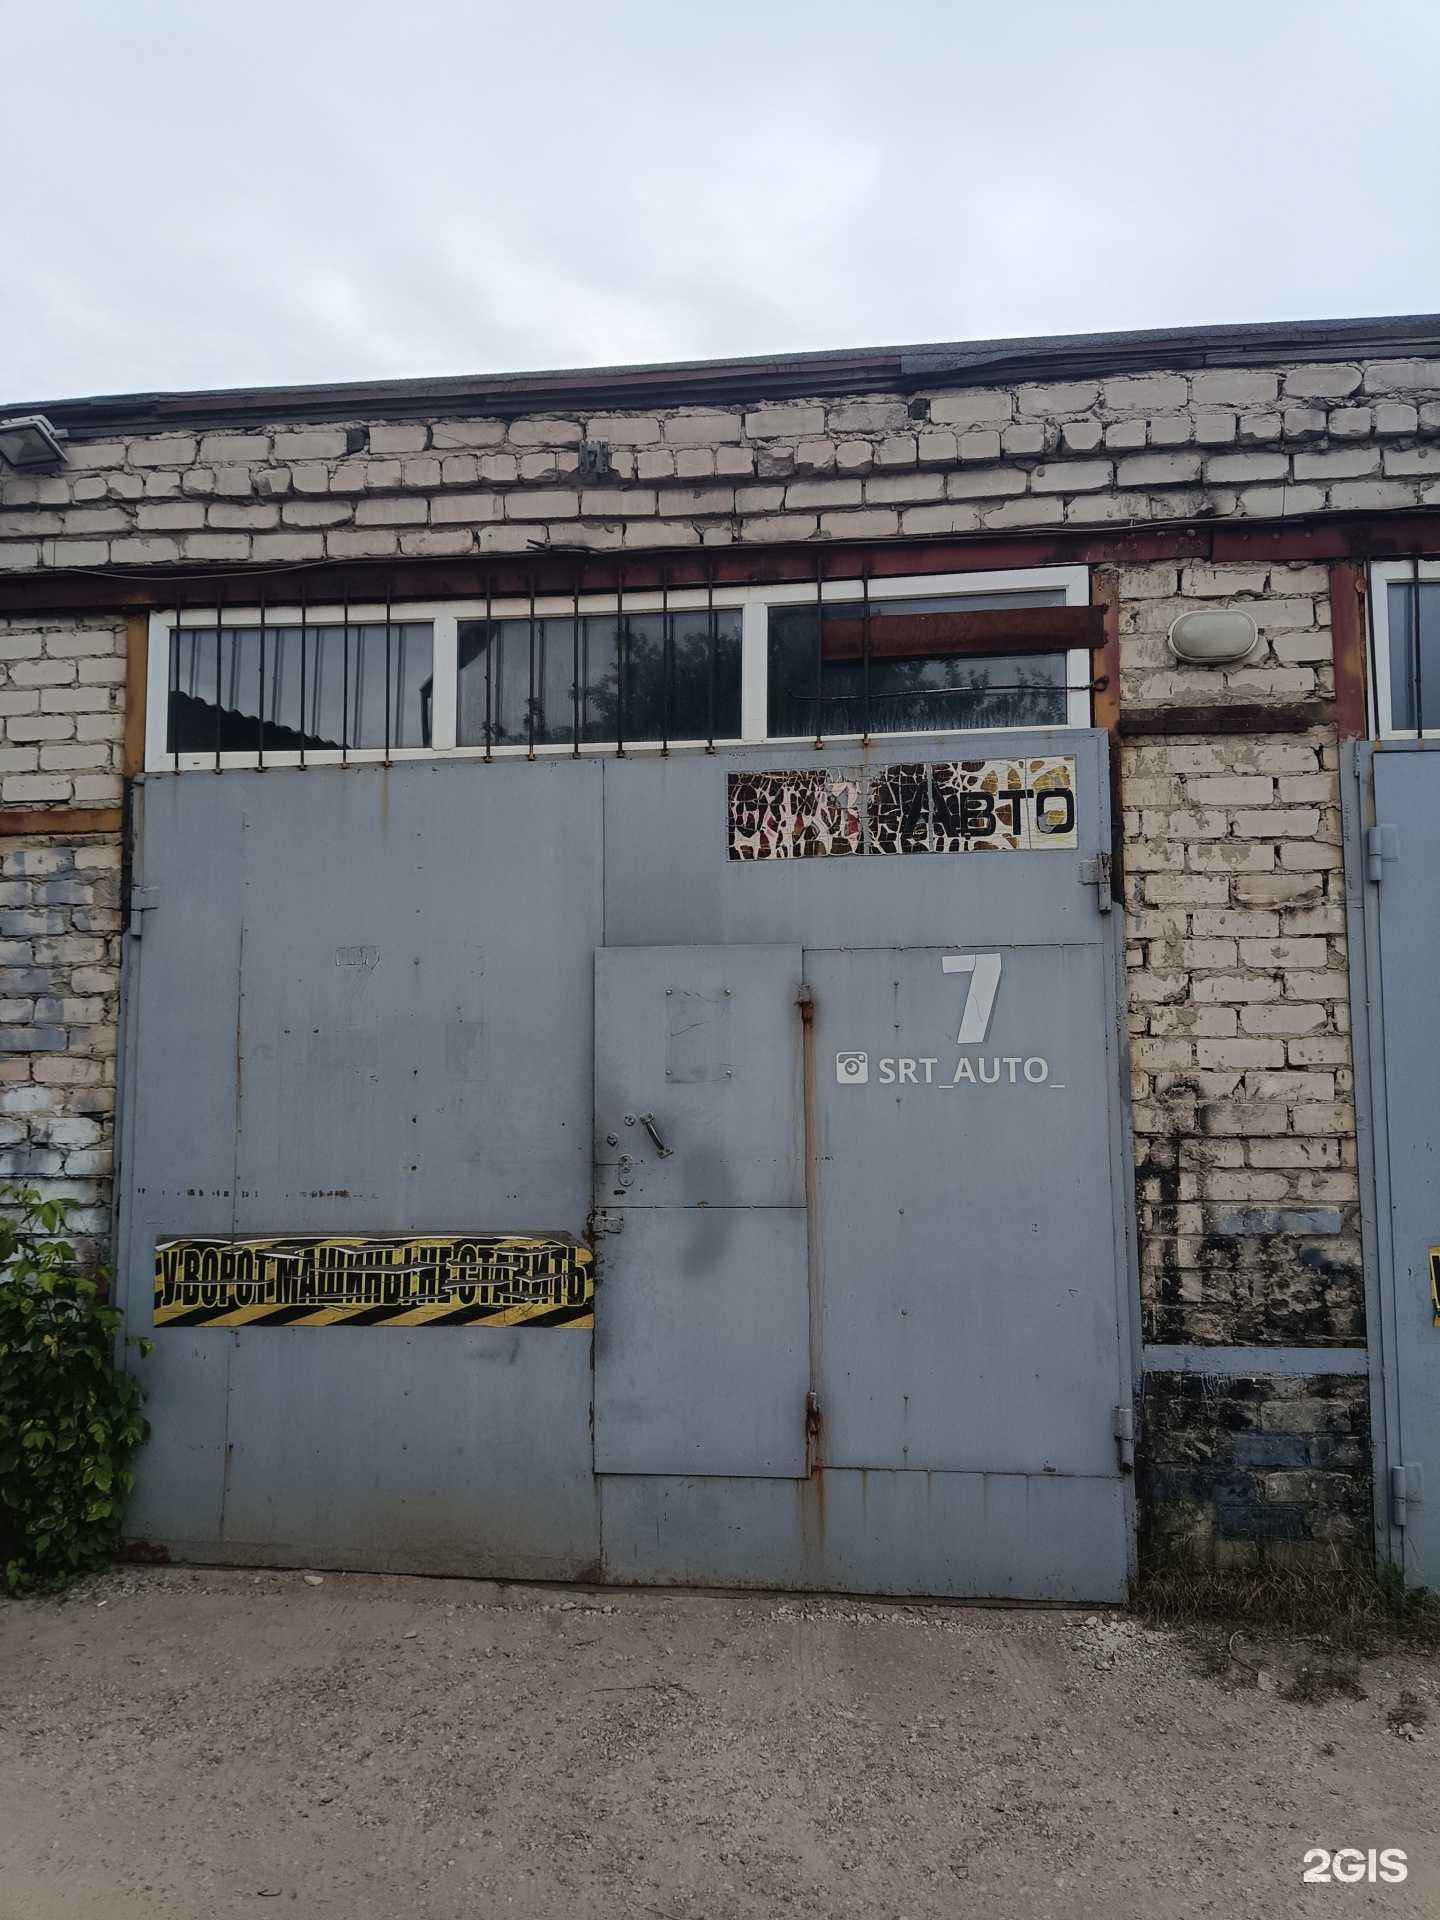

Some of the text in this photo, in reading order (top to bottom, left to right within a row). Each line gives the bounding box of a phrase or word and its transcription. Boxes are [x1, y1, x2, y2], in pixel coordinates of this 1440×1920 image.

[942, 952, 1002, 1044] 7
[878, 1056, 1066, 1089] SRT_AUTO_
[161, 1250, 180, 1307] У
[182, 1247, 274, 1307] ВОРОТ
